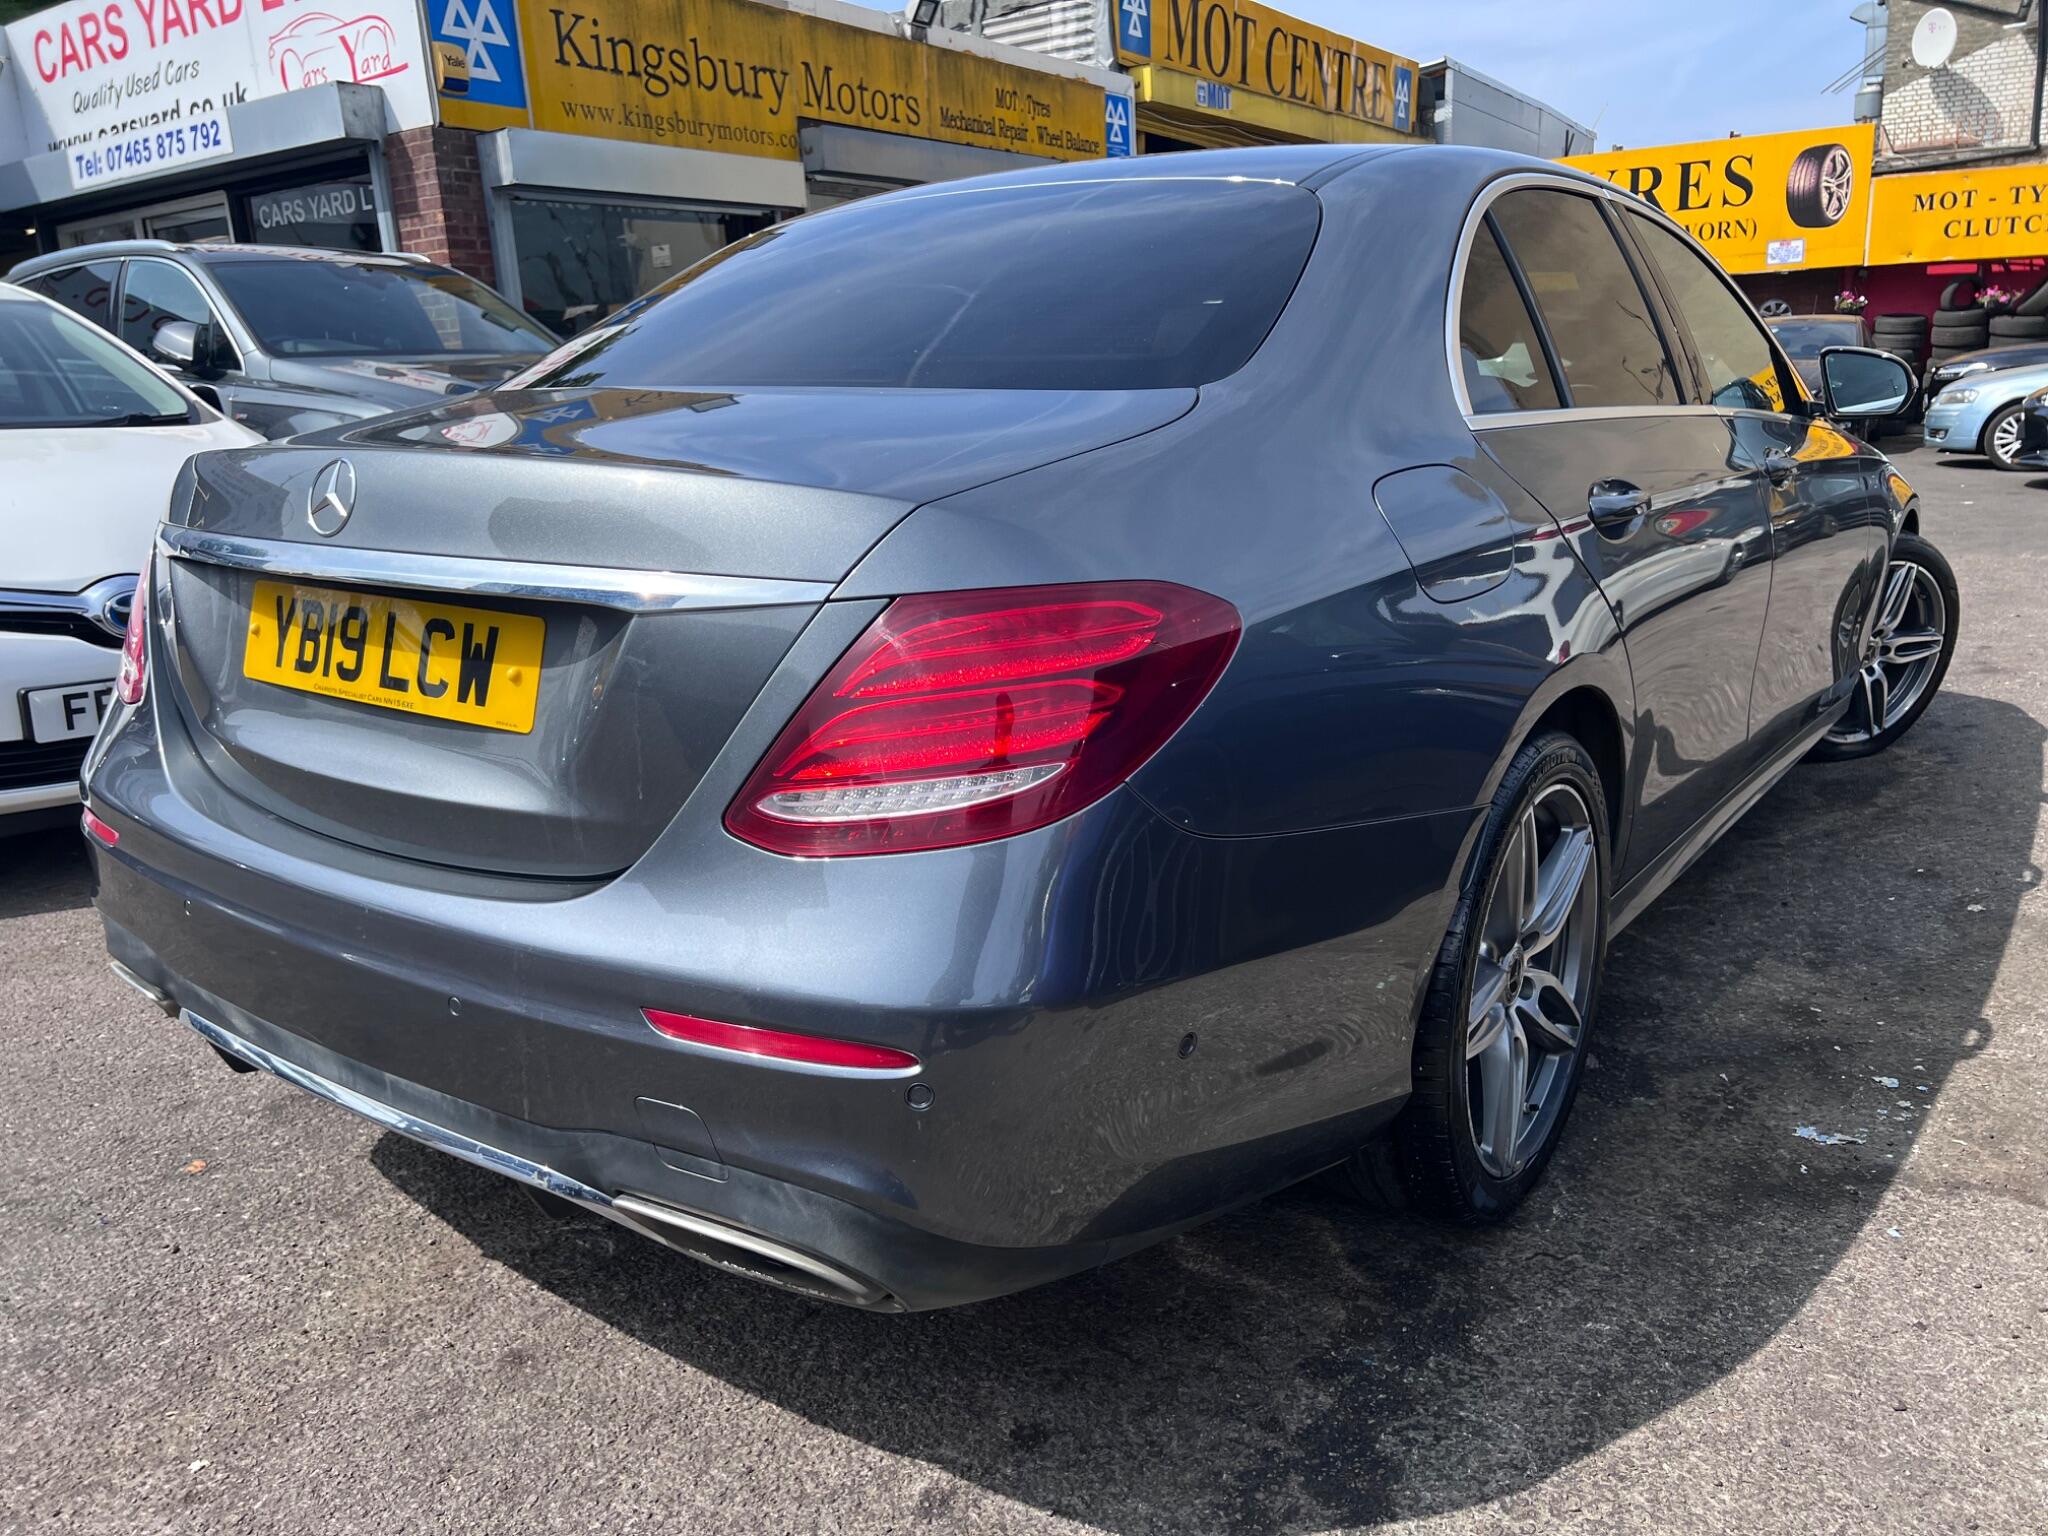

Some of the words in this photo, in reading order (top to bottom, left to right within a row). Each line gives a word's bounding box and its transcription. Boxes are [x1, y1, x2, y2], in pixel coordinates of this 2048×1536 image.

[34, 3, 129, 83] CARS
[134, 0, 242, 48] YARD
[444, 54, 465, 68] Yale
[549, 9, 789, 116] Kingsbury
[800, 61, 921, 126] Motors
[1164, 0, 1257, 86] MOT
[1265, 26, 1386, 121] CENTRE
[73, 78, 123, 114] Quality
[126, 62, 161, 98] Used
[165, 60, 200, 86] Cars
[995, 88, 1017, 110] MOT
[1027, 94, 1051, 120] Tyres
[75, 153, 102, 180] Tel:
[106, 138, 152, 172] 07465
[156, 127, 185, 160] 875
[189, 119, 221, 152] 792
[940, 106, 996, 136] Mechanical
[998, 118, 1029, 144] Repair
[1037, 126, 1063, 149] Wheel
[1065, 131, 1100, 155] Balance
[260, 199, 306, 229] CARS
[307, 189, 356, 220] YARD
[360, 184, 374, 211] L
[1589, 154, 1754, 213] RES
[1912, 189, 1978, 212] MOT
[2010, 183, 2048, 205] TY
[1944, 214, 2048, 239] CLUTC
[275, 595, 368, 683] YB19
[379, 611, 500, 708] LCW
